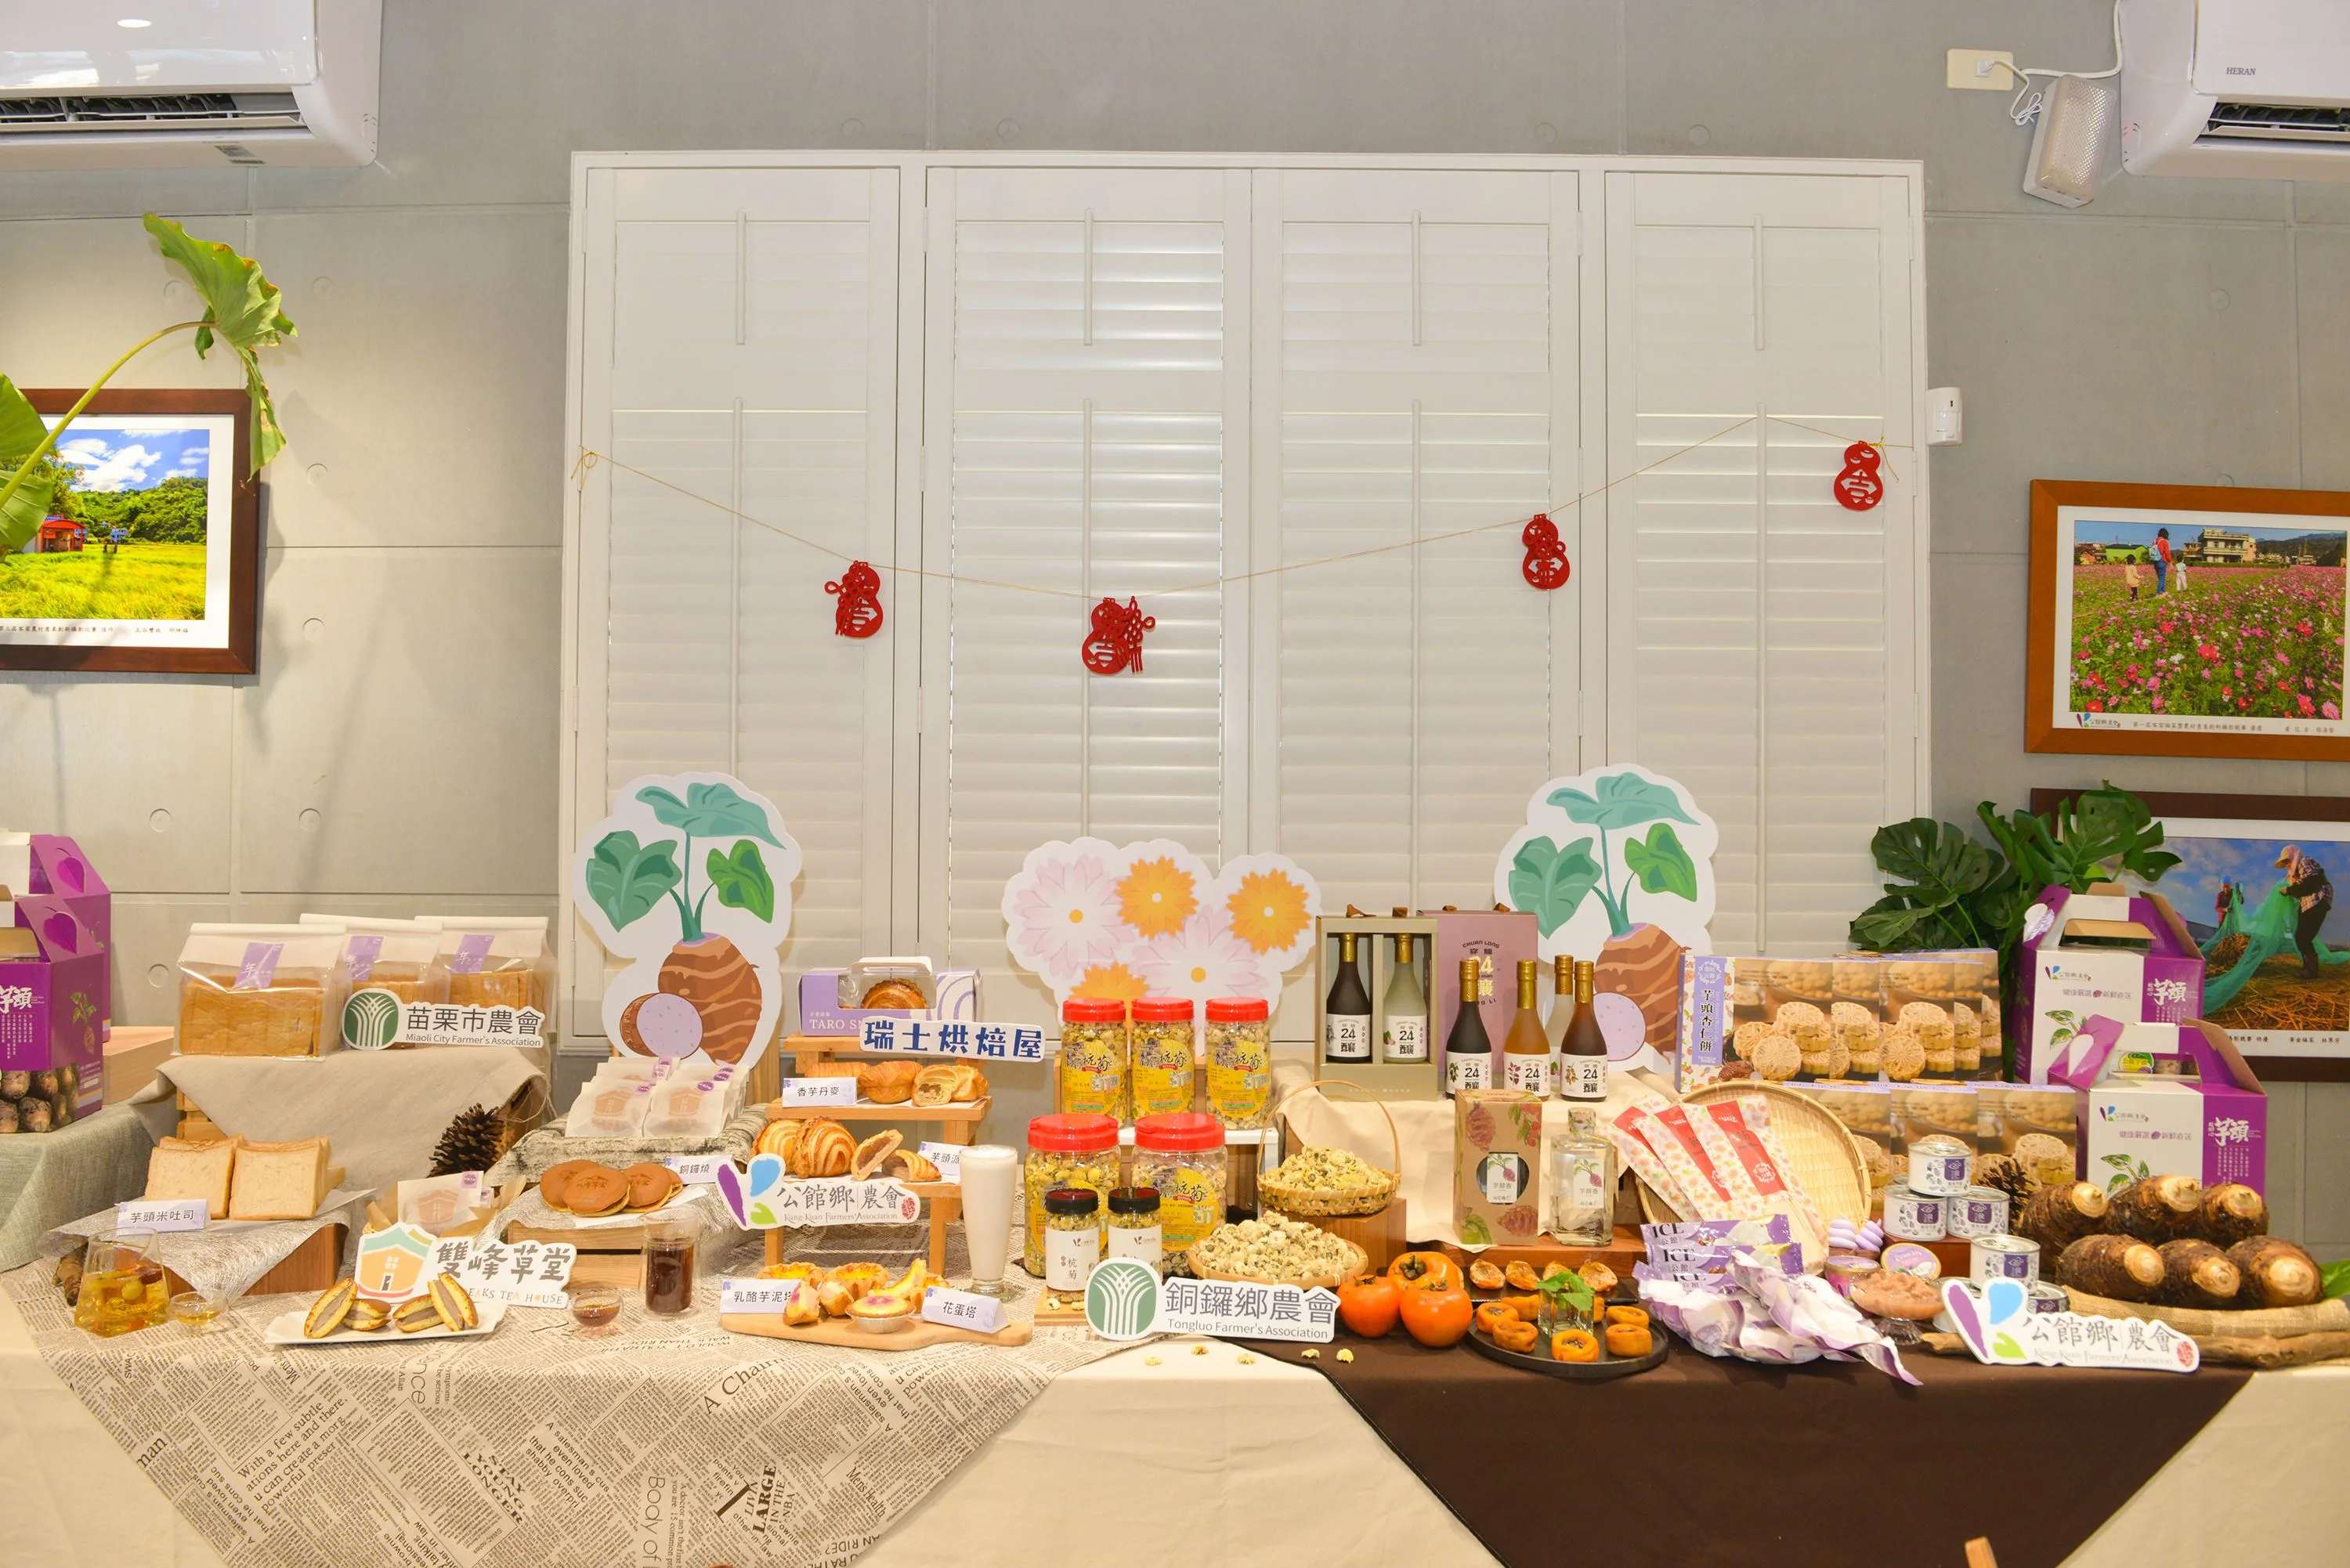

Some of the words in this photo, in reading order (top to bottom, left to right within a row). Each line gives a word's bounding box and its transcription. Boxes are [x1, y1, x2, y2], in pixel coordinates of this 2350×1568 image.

[2225, 67, 2256, 76] HERAN
[2154, 978, 2187, 1006] 芋頭
[406, 1006, 542, 1035] 苗栗市農會
[809, 1019, 844, 1029] TARO
[1700, 989, 1714, 1052] 芋頭杏仁餅
[406, 1033, 432, 1042] Miaoli
[433, 1034, 451, 1045] City
[452, 1035, 490, 1045] Farmer's
[491, 1036, 541, 1047] Association
[863, 1020, 1042, 1059] 瑞士烘焙屋
[1340, 1028, 1357, 1039] 24
[1399, 1030, 1415, 1041] 24
[1464, 1067, 1480, 1078] 24
[1524, 1068, 1540, 1079] 24
[1583, 1068, 1599, 1080] 24
[797, 1086, 840, 1097] 香芋丹麥
[2214, 1117, 2249, 1147] 芋頭
[679, 1163, 710, 1174] 銅鑼燒
[931, 1152, 960, 1165] 芋頭派
[776, 1183, 906, 1212] 公館鄉農會
[130, 1209, 194, 1223] 芋頭米吐司
[1652, 1224, 1684, 1237] ICE
[436, 1241, 571, 1284] 雙峰草堂
[1663, 1248, 1695, 1262] ICE
[468, 1288, 495, 1299] EAKS
[501, 1290, 520, 1301] TEA
[525, 1293, 563, 1305] HOUSE
[1165, 1282, 1337, 1324] 銅鑼鄉農會
[942, 1301, 978, 1319] 花蛋塔
[1167, 1318, 1213, 1333] Tongluo
[1215, 1321, 1264, 1335] Farmer's
[1264, 1324, 1329, 1339] Association
[2023, 1317, 2180, 1353] 公館鄉農會
[703, 1396, 721, 1414] A
[237, 1454, 266, 1479] With
[273, 1429, 295, 1449] few
[293, 1401, 324, 1432] subtle
[246, 1462, 278, 1492] ations
[277, 1440, 302, 1462] here
[301, 1422, 320, 1442] and
[526, 1448, 552, 1477] shabby
[529, 1436, 546, 1454] that
[544, 1452, 556, 1465] he
[555, 1465, 574, 1487] cons
[573, 1486, 588, 1503] suc
[545, 1422, 554, 1431] A
[595, 1476, 609, 1492] cus
[552, 1445, 573, 1467] even
[572, 1465, 595, 1489] loved
[254, 1493, 263, 1501] u
[263, 1475, 284, 1494] can
[283, 1449, 314, 1476] create
[313, 1441, 320, 1450] a
[476, 1453, 526, 1511] YOUNG
[488, 1454, 525, 1494] STAY
[732, 1464, 745, 1479] You
[207, 1477, 229, 1503] loved
[224, 1483, 243, 1504] cons
[261, 1469, 306, 1515] powerful
[462, 1451, 523, 1524] LONGER
[753, 1465, 776, 1534] LARGE
[773, 1480, 786, 1508] THE
[228, 1501, 248, 1523] even
[243, 1504, 254, 1516] he
[640, 1476, 666, 1535] Body
[679, 1491, 688, 1516] doctor
[783, 1493, 796, 1518] NBA
[863, 1488, 887, 1518] Health
[255, 1515, 270, 1534] that
[771, 1509, 780, 1523] IN
[642, 1540, 662, 1562] of
